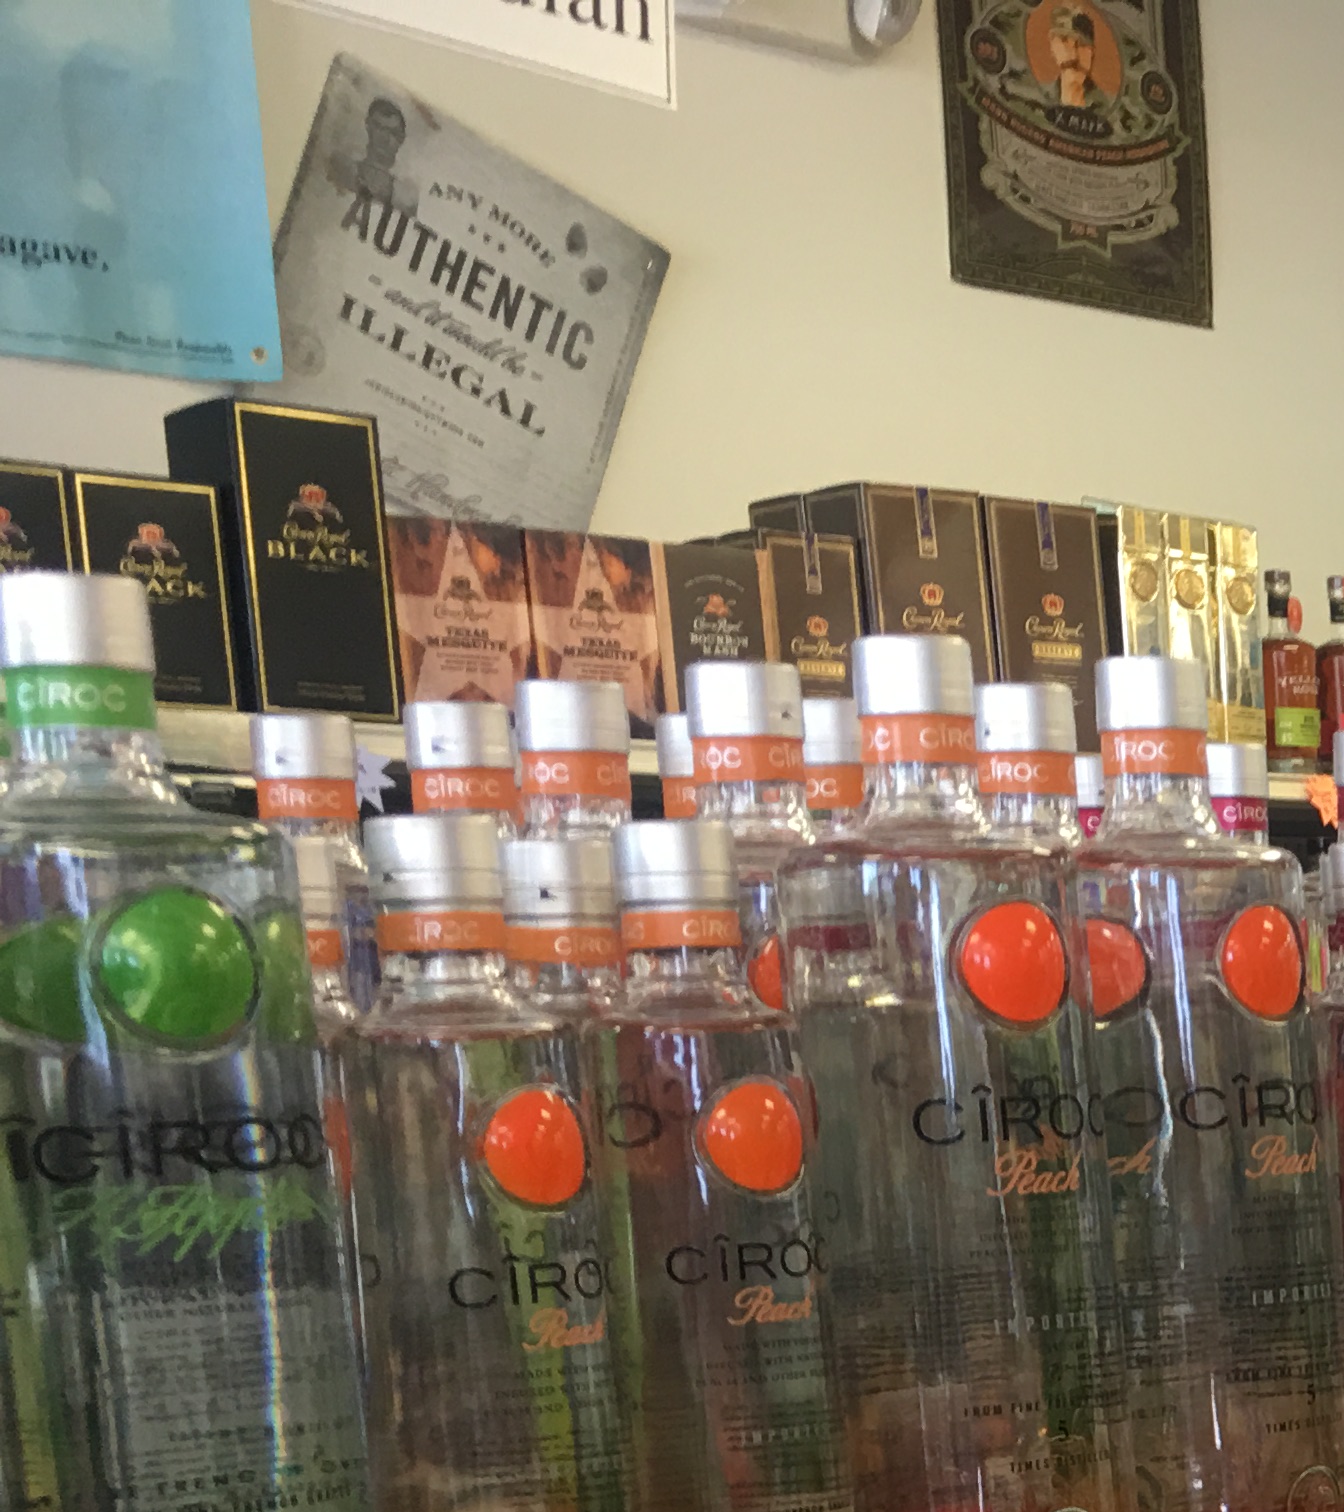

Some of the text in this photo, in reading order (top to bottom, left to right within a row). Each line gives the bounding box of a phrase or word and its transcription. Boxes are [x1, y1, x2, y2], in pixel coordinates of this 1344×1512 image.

[341, 196, 595, 371] AUTHENTIC
[338, 292, 547, 438] ILLEGAL
[266, 539, 370, 570] BLACK
[146, 578, 207, 601] ACK
[986, 1148, 1082, 1198] Peach
[1244, 1133, 1320, 1180] Peach
